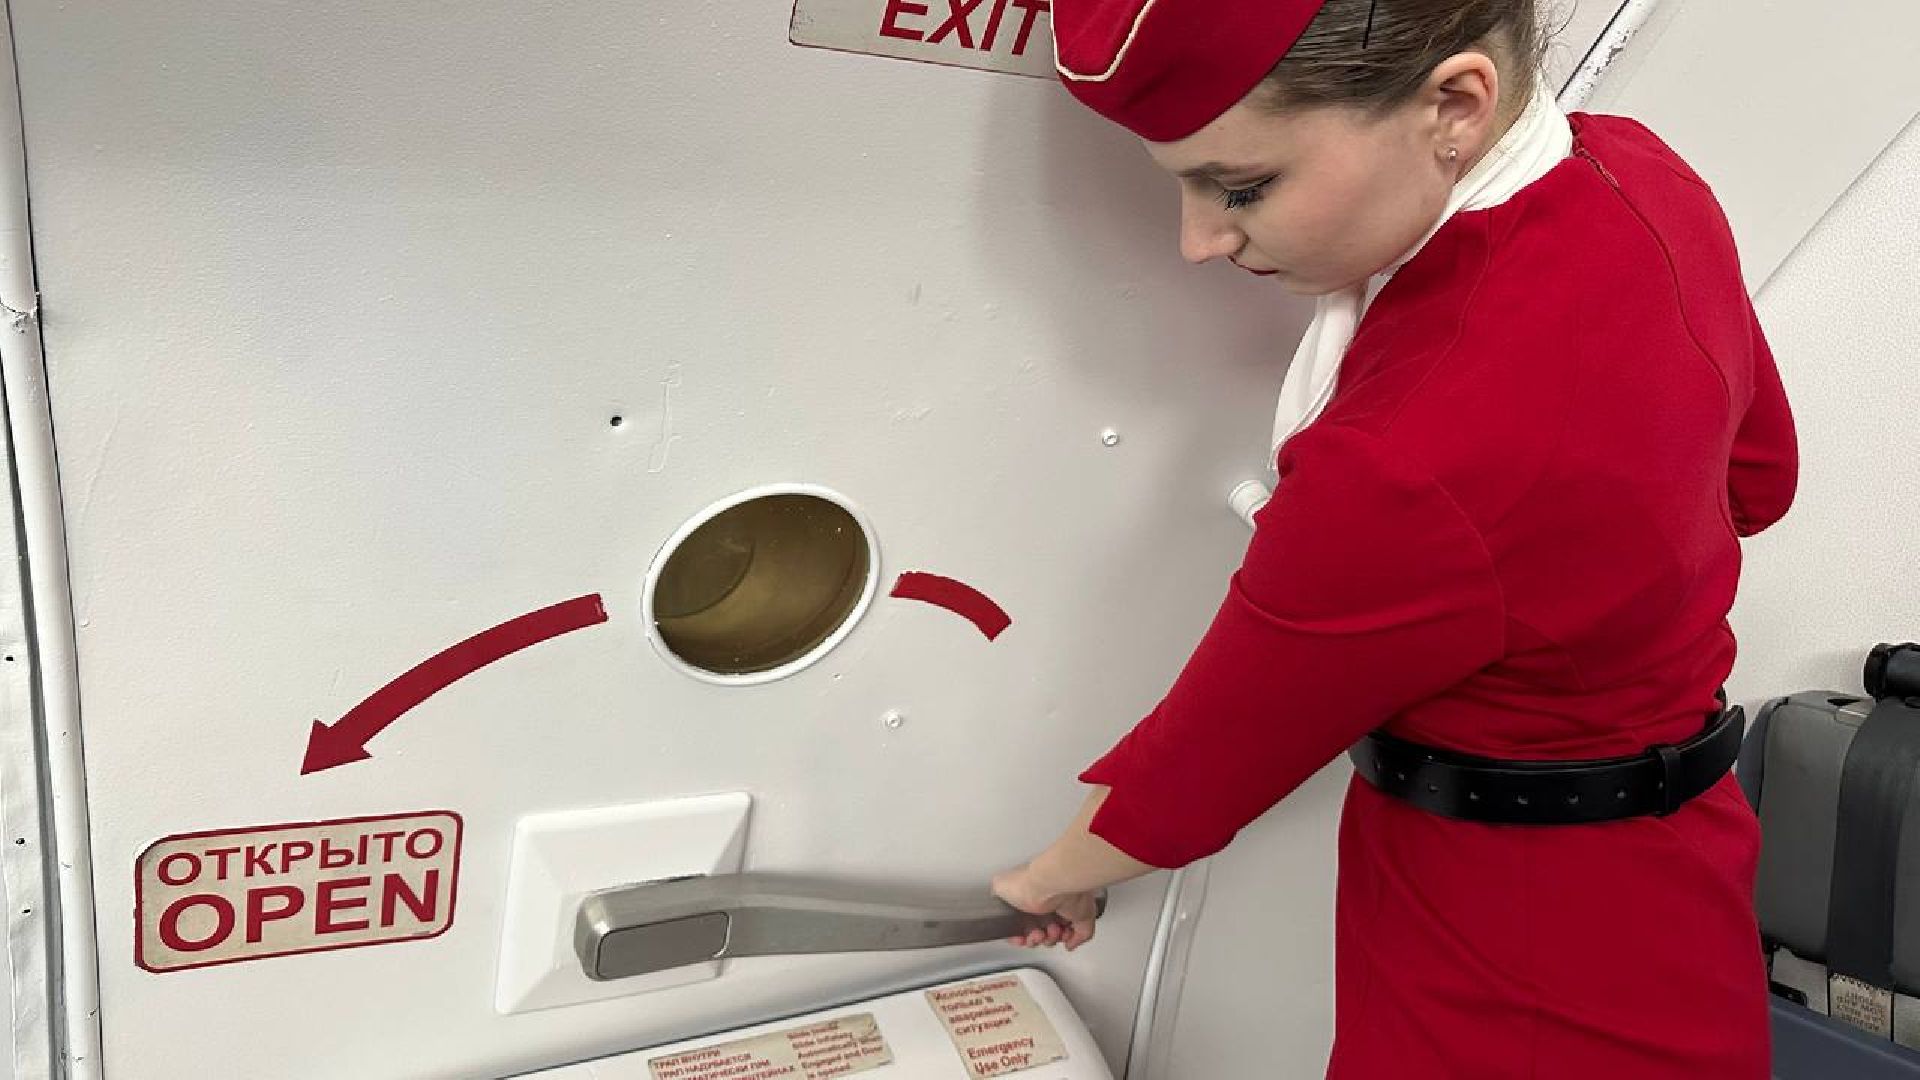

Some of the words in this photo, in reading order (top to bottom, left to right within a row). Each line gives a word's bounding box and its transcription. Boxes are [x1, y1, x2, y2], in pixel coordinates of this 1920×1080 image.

[879, 0, 1050, 56] EXIT
[157, 828, 443, 885] ОТКРЫТО
[159, 869, 439, 952] OPEN
[966, 1036, 1034, 1060] Emergency
[974, 1060, 999, 1074] Use
[1000, 1054, 1032, 1067] Only
